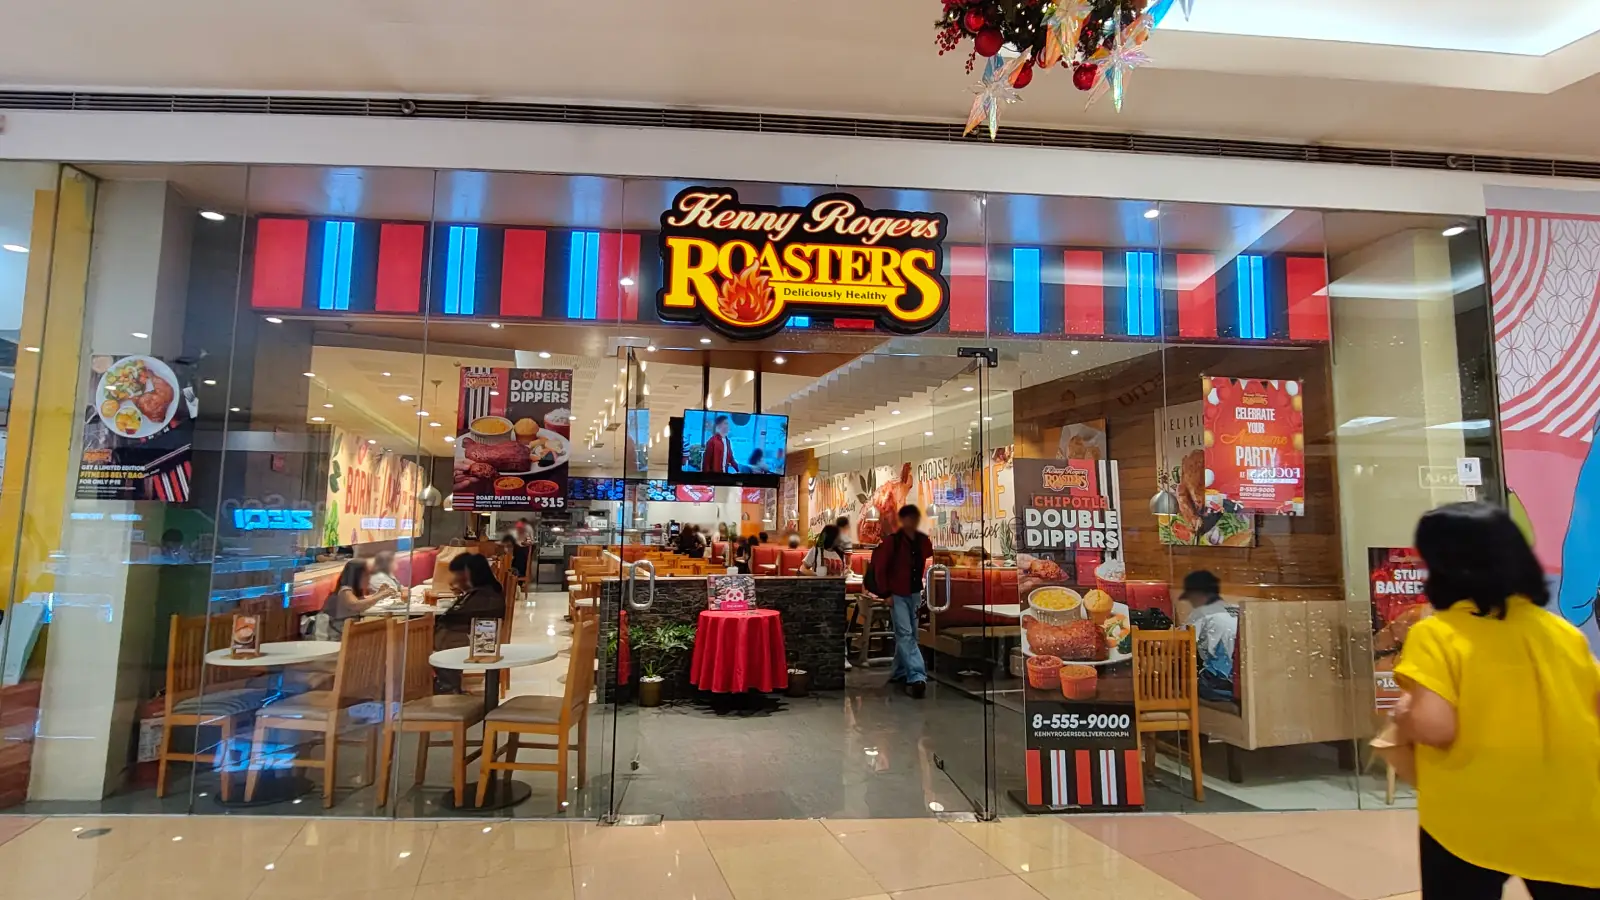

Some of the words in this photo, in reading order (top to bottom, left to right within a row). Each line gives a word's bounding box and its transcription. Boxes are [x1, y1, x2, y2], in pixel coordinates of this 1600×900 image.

[667, 192, 801, 242] Kenny
[803, 200, 941, 246] Rogers
[663, 236, 944, 328] ROASTERS
[783, 287, 843, 300] Deliciously
[845, 289, 888, 302] Healthy
[510, 379, 570, 392] DOUBLE
[510, 391, 569, 404] DIPPERS
[1235, 406, 1276, 421] CELEBRATE
[1247, 421, 1265, 434] YOUR
[1235, 446, 1277, 468] PARTY
[917, 458, 948, 482] CHOOSE
[1043, 474, 1088, 490] ROASTERS
[345, 466, 372, 515] BORN
[1034, 495, 1108, 509] CHIPOTLE
[1025, 508, 1118, 529] DOUBLE
[1026, 529, 1119, 549] DIPPERS
[1032, 713, 1130, 729] 8-555-9000
[1034, 730, 1130, 738] KENNYROGERSDELIVERY.COM.PH
